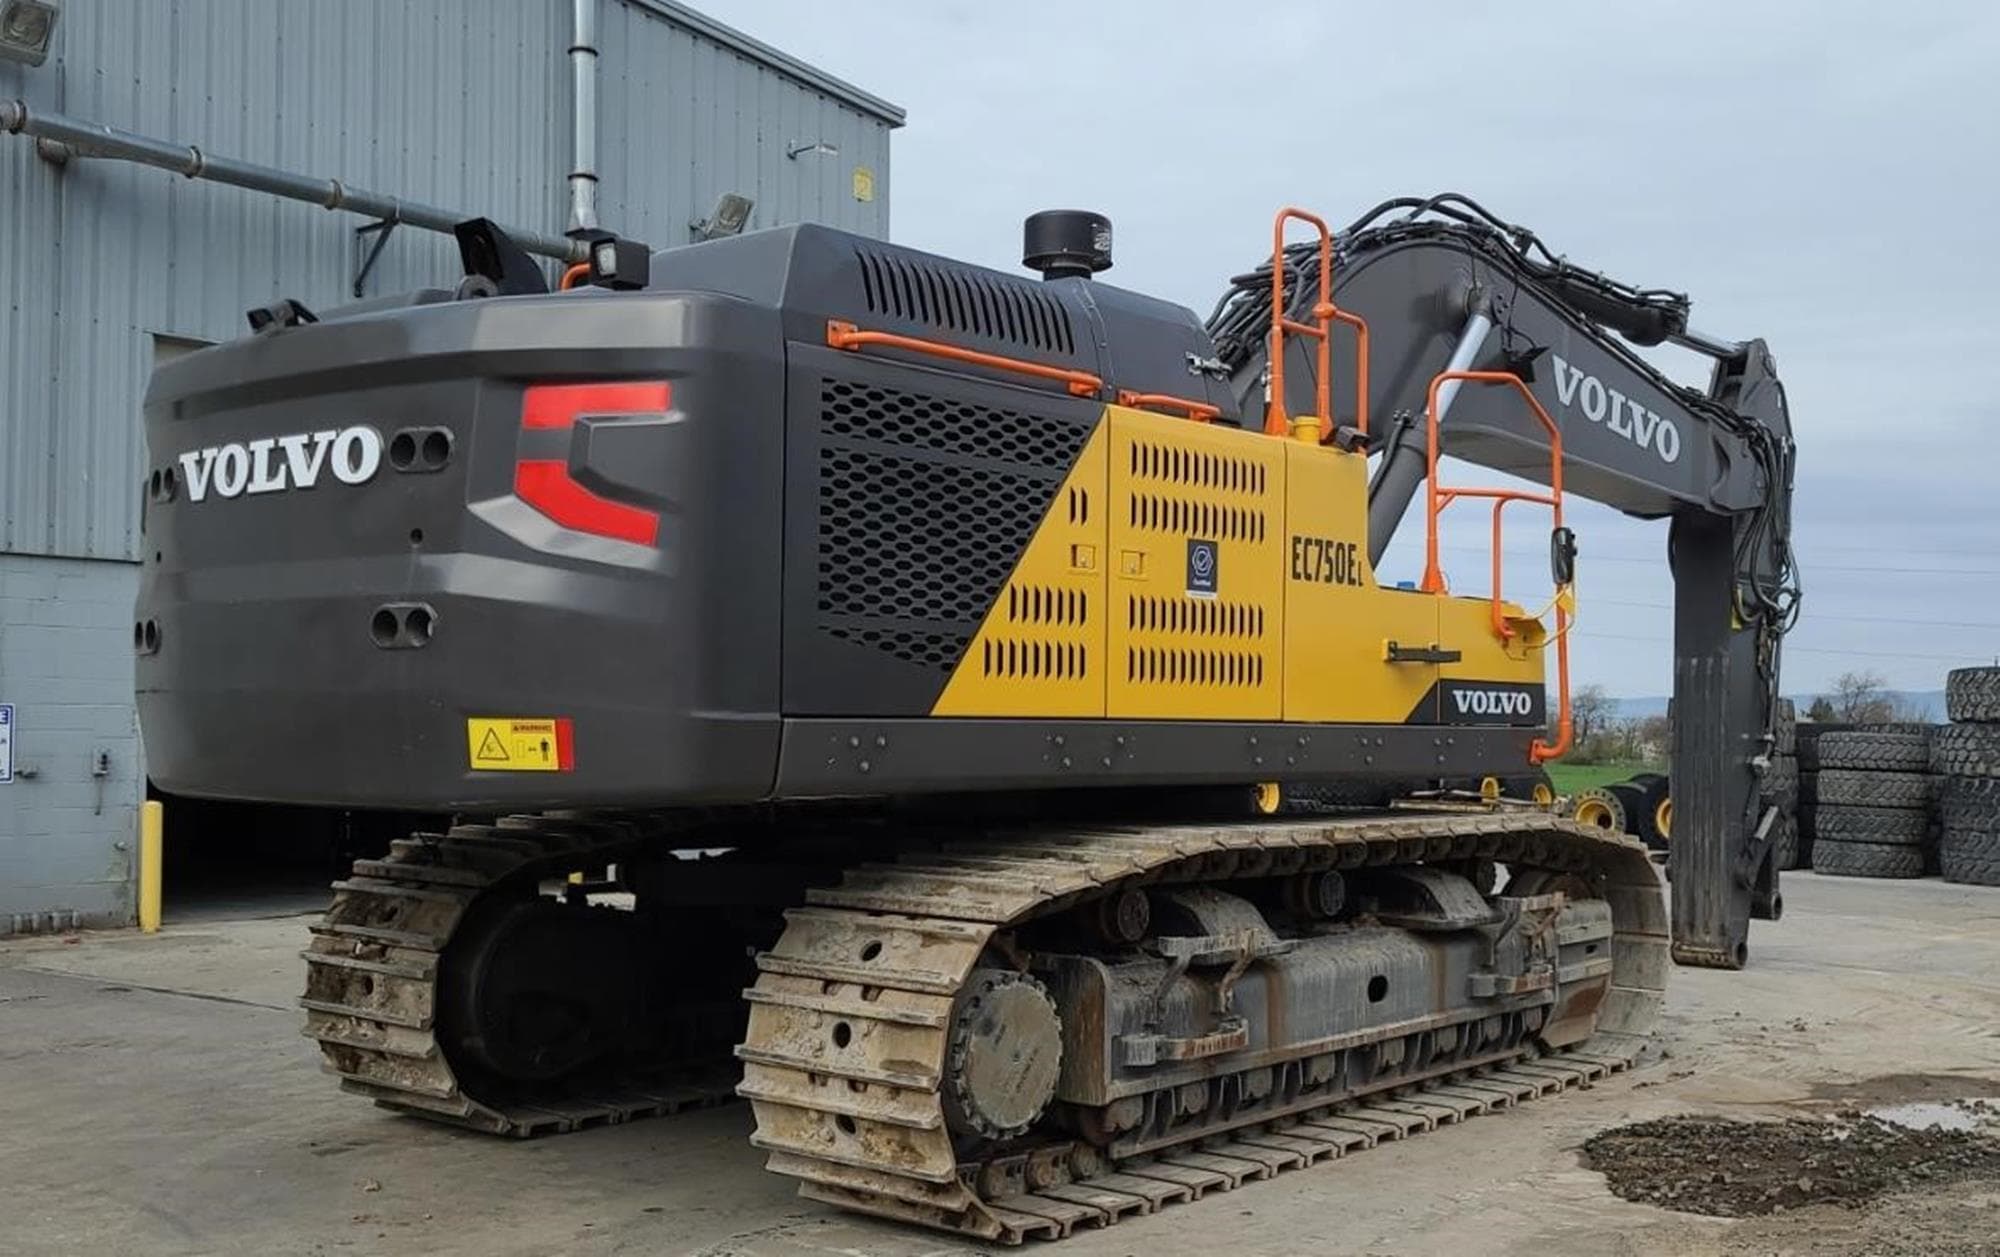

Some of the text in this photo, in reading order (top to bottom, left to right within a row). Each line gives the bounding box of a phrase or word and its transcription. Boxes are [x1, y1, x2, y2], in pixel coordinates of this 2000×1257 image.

[1552, 354, 1680, 463] VOLVO
[179, 426, 384, 501] VOLVO
[1452, 689, 1532, 715] VOLVO
